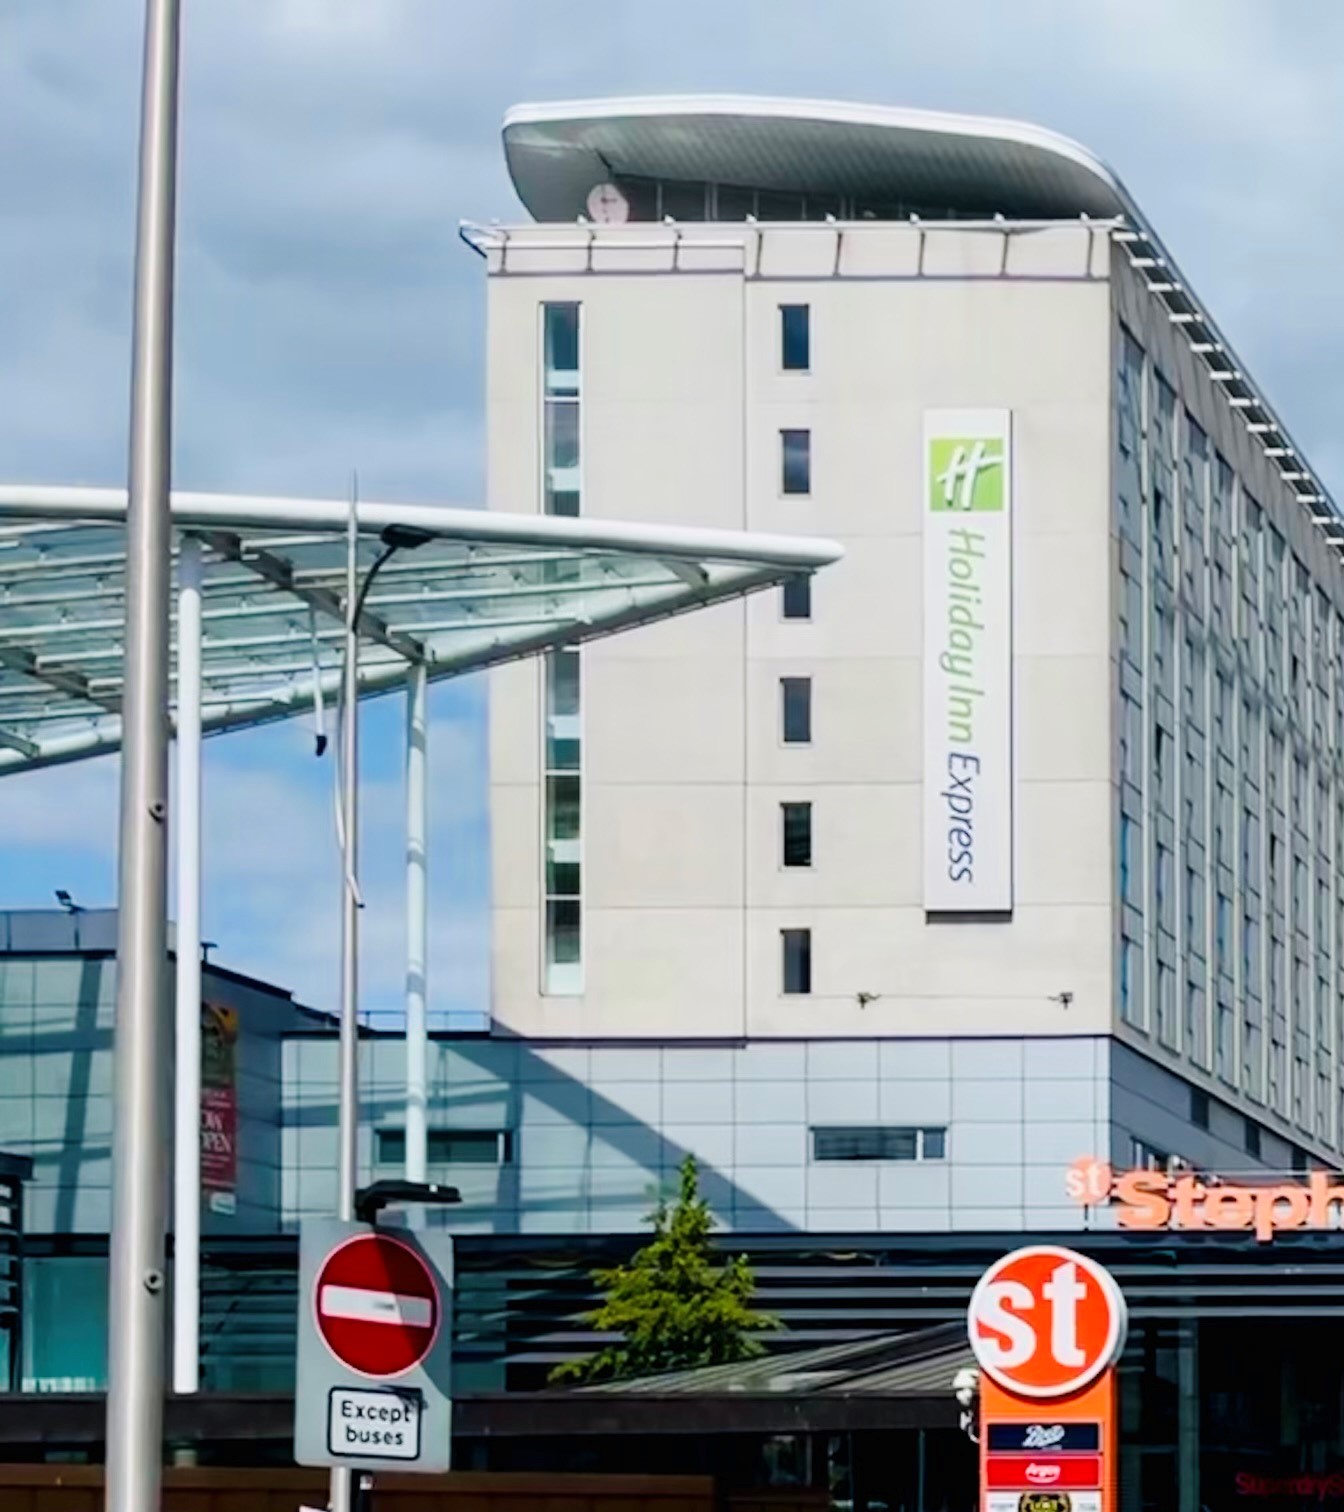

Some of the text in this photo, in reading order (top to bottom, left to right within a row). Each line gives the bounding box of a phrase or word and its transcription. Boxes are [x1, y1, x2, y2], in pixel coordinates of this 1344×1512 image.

[939, 527, 986, 884] Holiday Inn Express
[972, 1260, 1088, 1370] st
[341, 1400, 411, 1425] Except
[345, 1424, 405, 1446] buses
